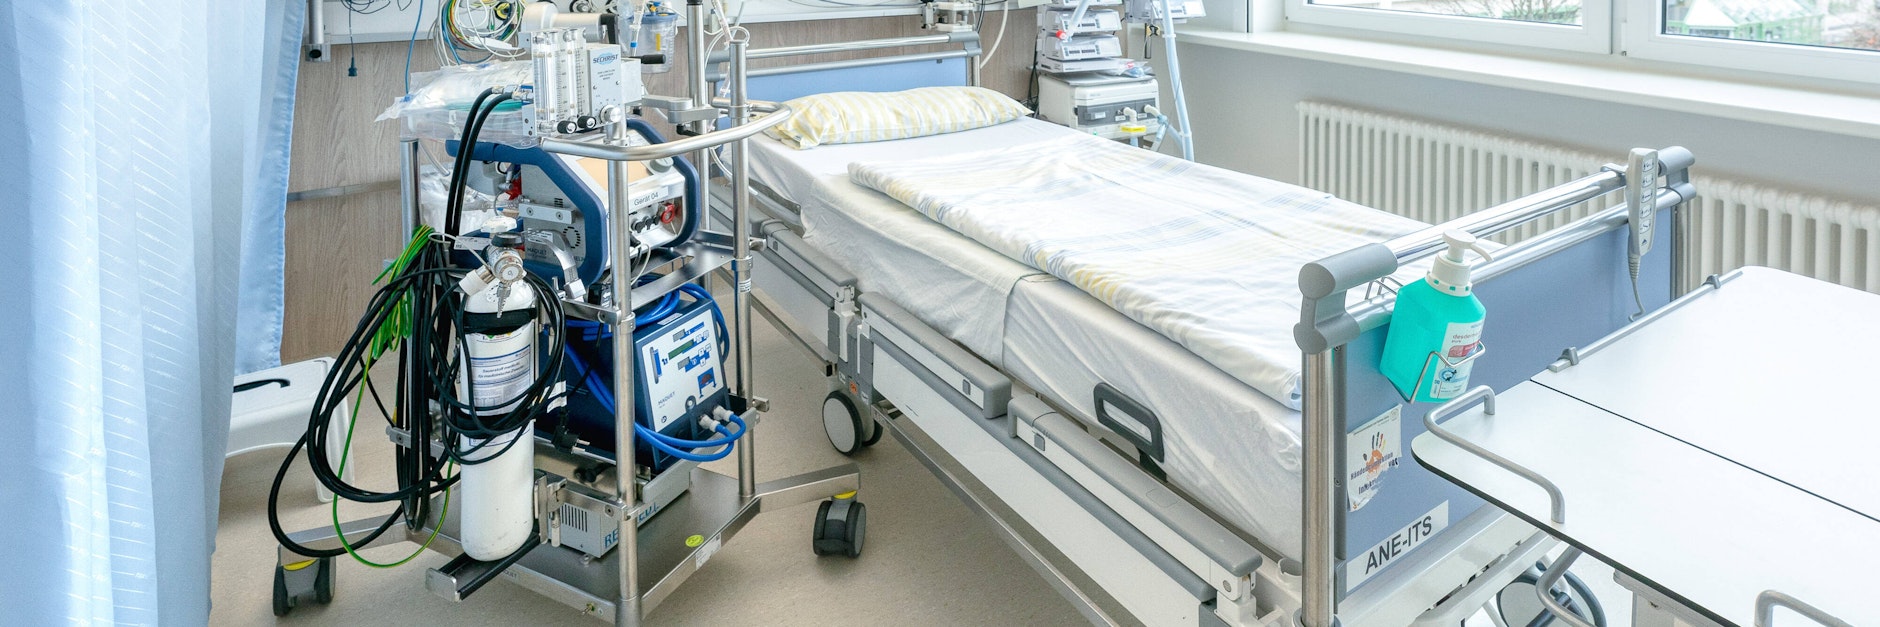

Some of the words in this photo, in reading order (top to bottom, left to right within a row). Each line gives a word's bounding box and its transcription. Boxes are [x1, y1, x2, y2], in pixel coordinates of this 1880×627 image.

[592, 54, 619, 64] SECHRIST
[650, 191, 659, 200] 04
[1365, 515, 1432, 575] ANE-ITS
